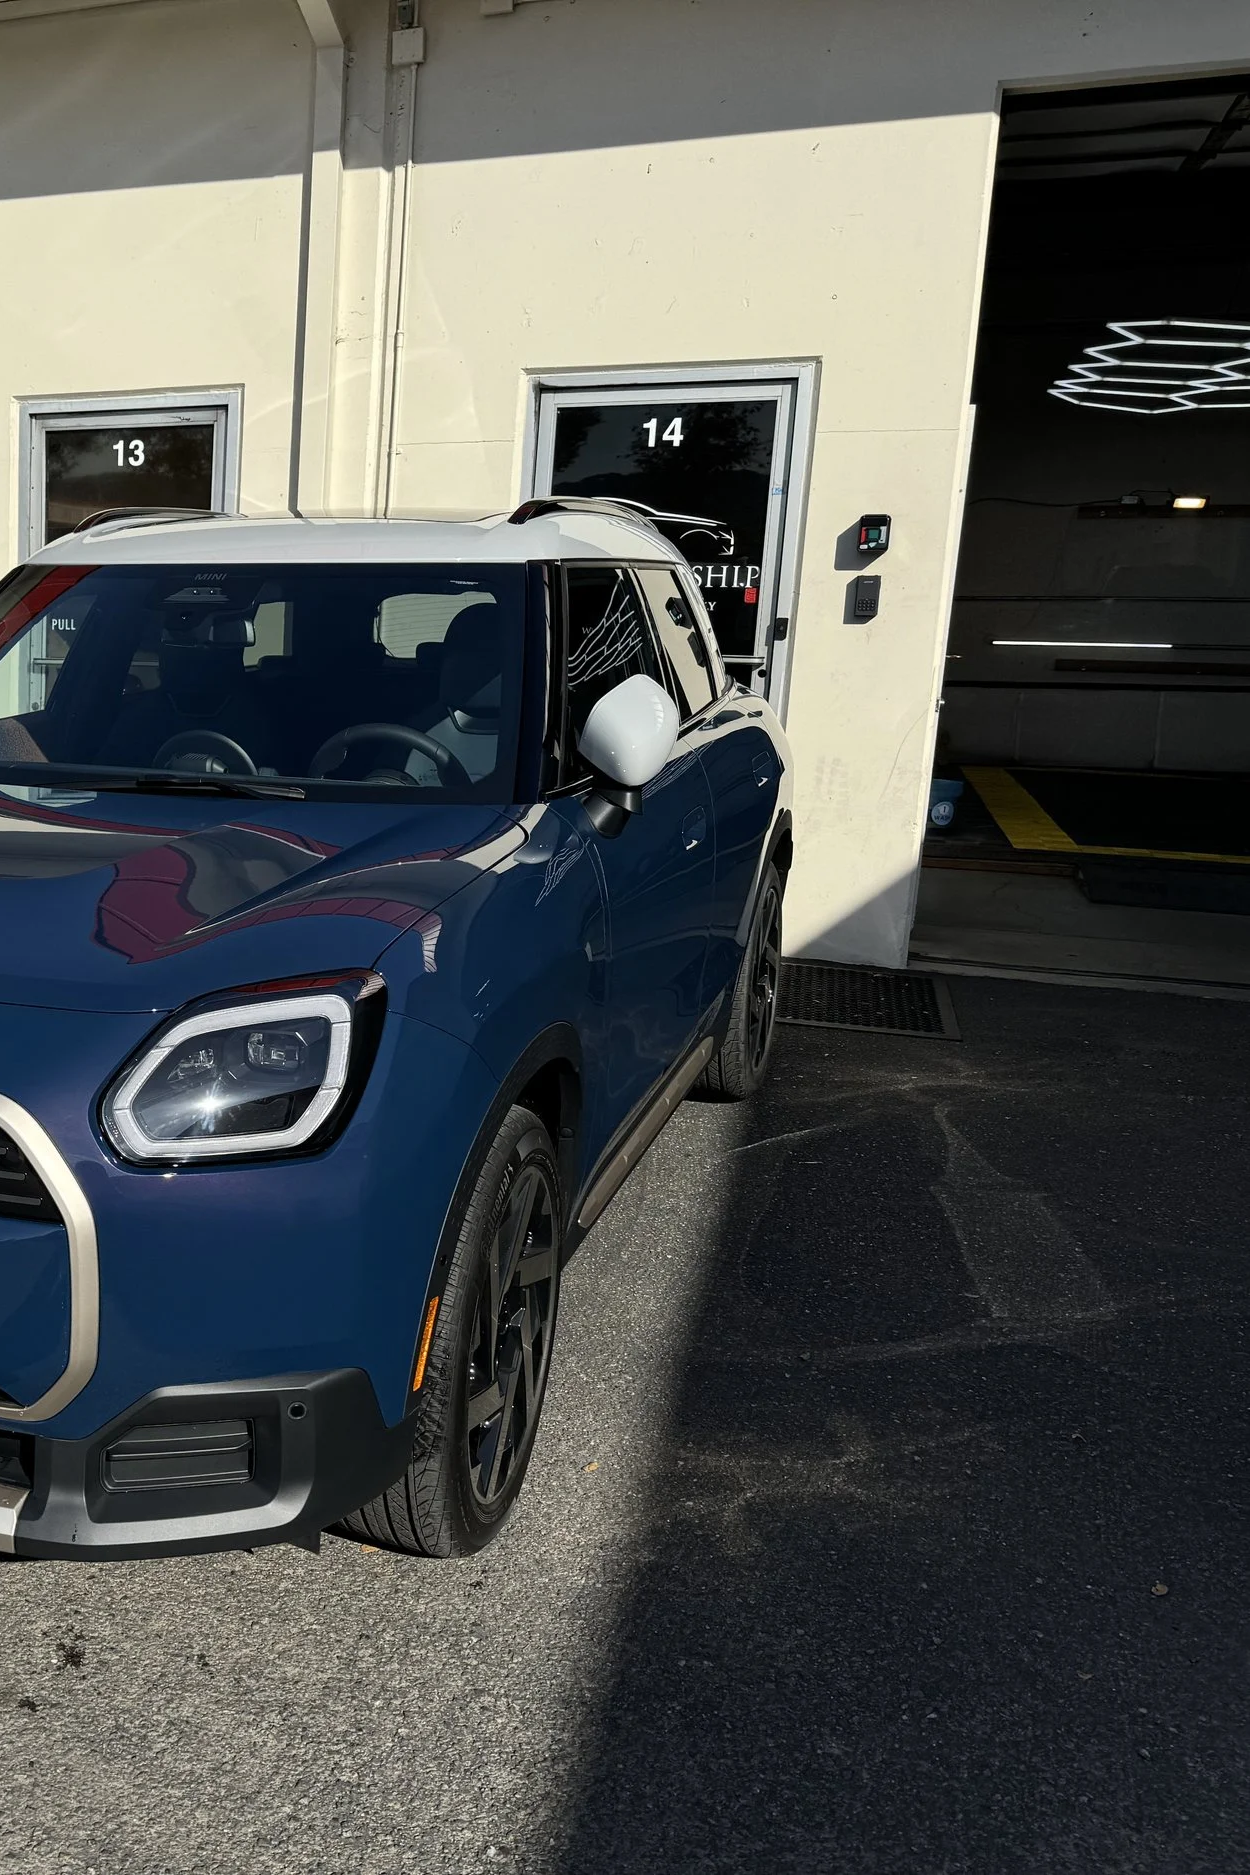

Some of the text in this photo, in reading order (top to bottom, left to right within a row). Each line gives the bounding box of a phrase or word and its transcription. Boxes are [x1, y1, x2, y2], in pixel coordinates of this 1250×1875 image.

[643, 417, 684, 447] 14
[112, 439, 145, 467] 13
[51, 618, 76, 630] PULL
